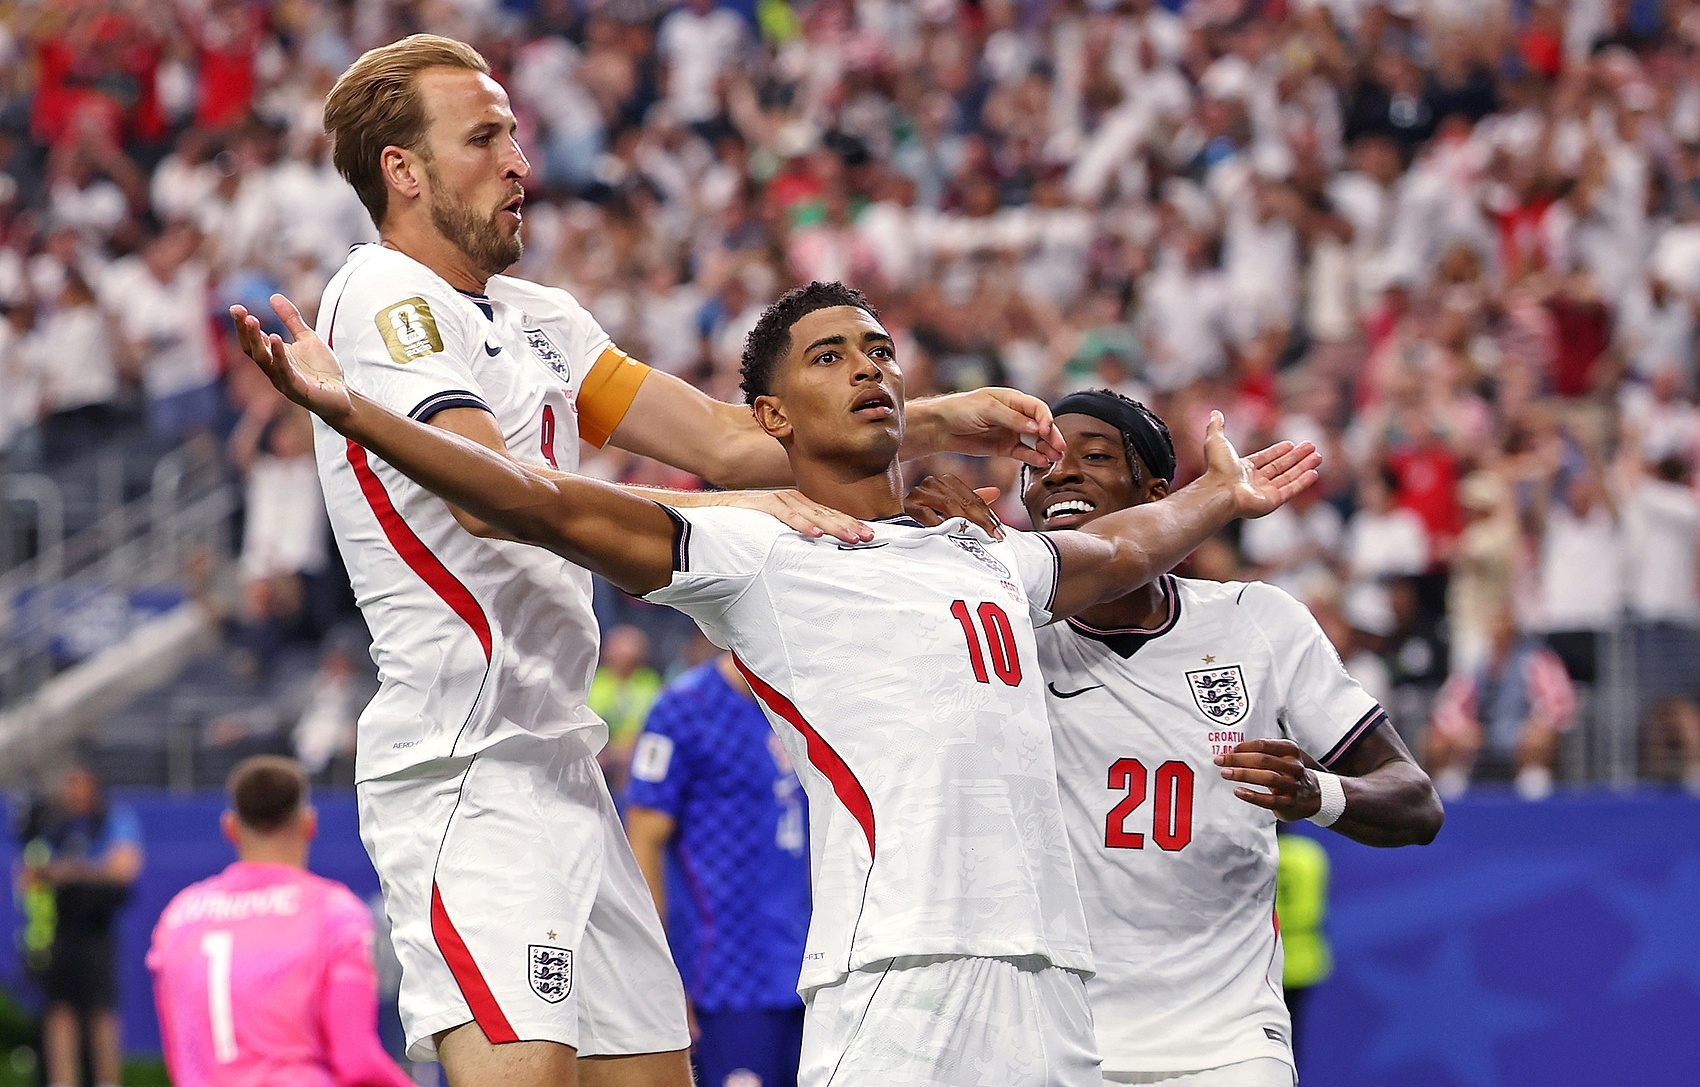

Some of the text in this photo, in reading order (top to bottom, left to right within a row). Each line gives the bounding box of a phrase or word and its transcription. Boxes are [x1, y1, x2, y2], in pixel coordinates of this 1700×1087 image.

[950, 599, 1023, 687] 10
[1208, 731, 1245, 742] CROATIA
[1105, 757, 1195, 852] 20
[203, 930, 238, 1065] 1
